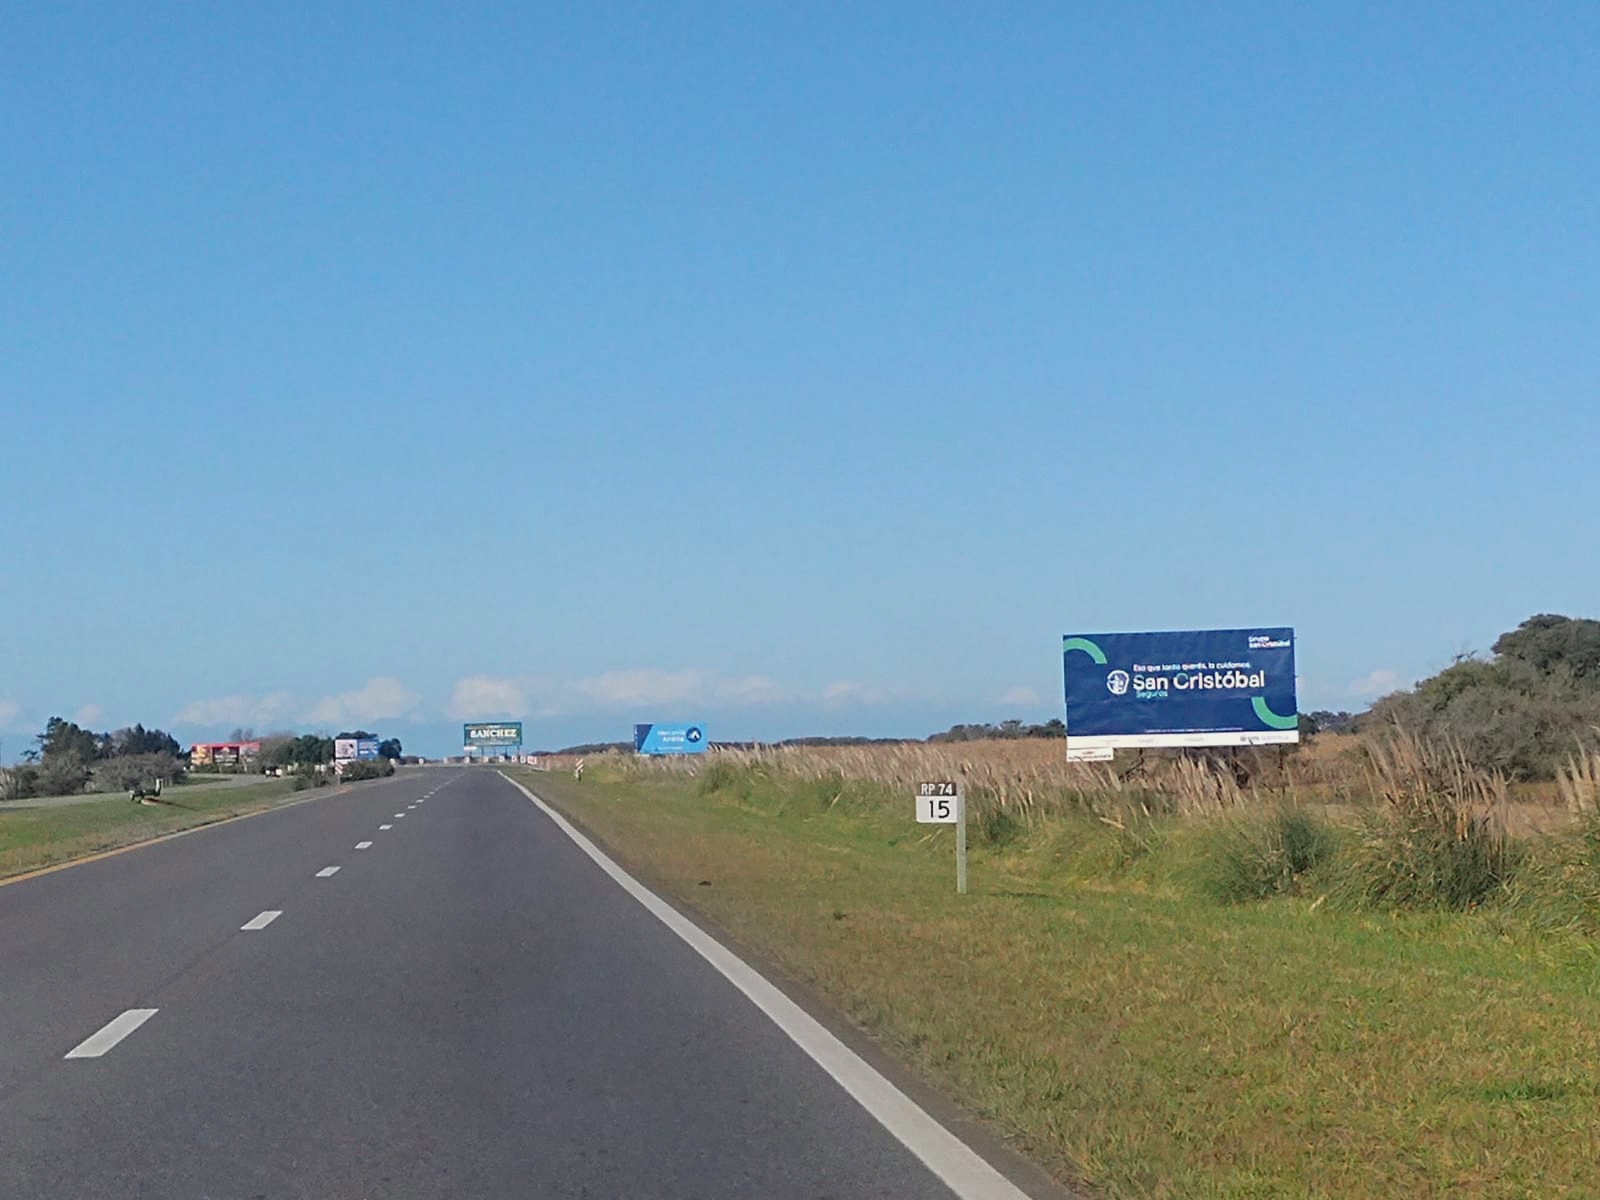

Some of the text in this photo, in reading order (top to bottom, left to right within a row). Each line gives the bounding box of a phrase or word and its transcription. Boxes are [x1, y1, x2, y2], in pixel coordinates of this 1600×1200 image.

[1133, 670, 1265, 691] San Cristóbal
[921, 783, 953, 795] RP 74
[929, 800, 950, 819] 15
